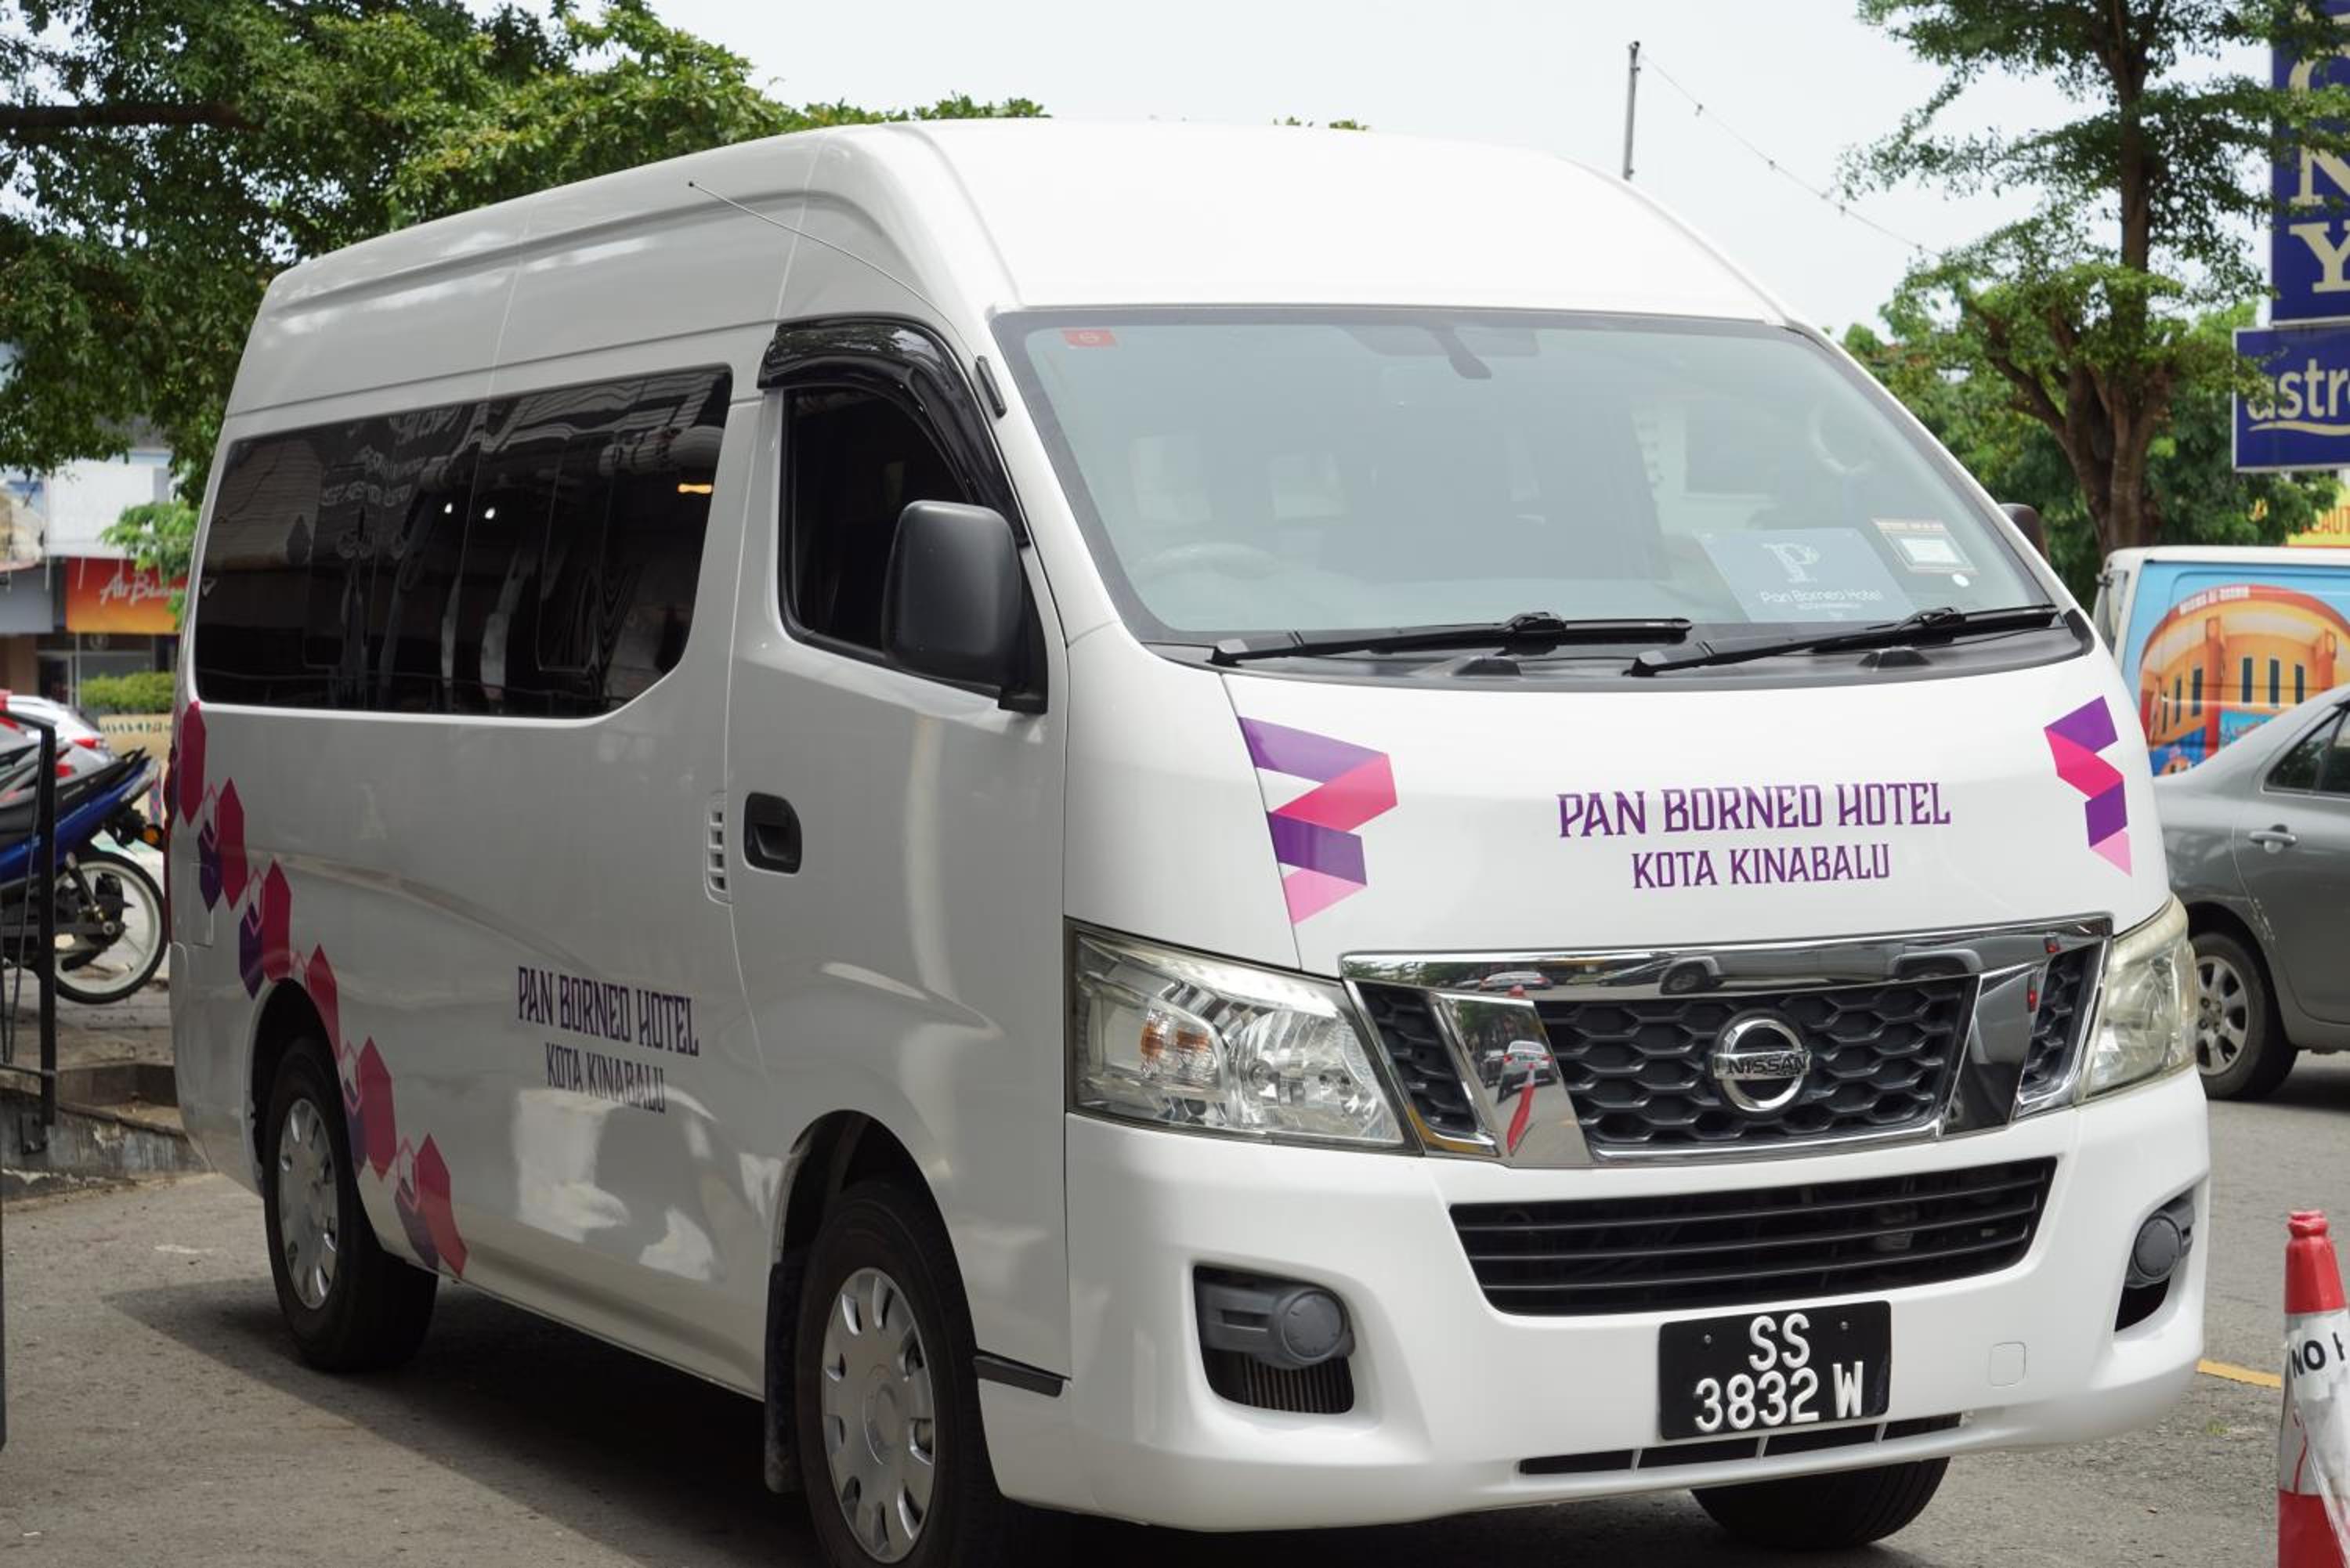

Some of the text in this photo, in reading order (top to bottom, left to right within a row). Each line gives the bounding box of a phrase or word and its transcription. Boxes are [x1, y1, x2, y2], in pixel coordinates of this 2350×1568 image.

[2247, 359, 2350, 420] astr
[1556, 782, 1951, 837] PAN BORNEO HOTEL
[1631, 843, 1891, 889] KOTA KINABALU
[518, 965, 700, 1057] PAN BORNEO HOTEL
[545, 1042, 666, 1114] KOTA KINABALU
[1727, 1057, 1806, 1074] NISSAN
[1748, 1312, 1810, 1371] SS
[2291, 1339, 2326, 1379] NO
[1694, 1360, 1864, 1433] 3832 W
